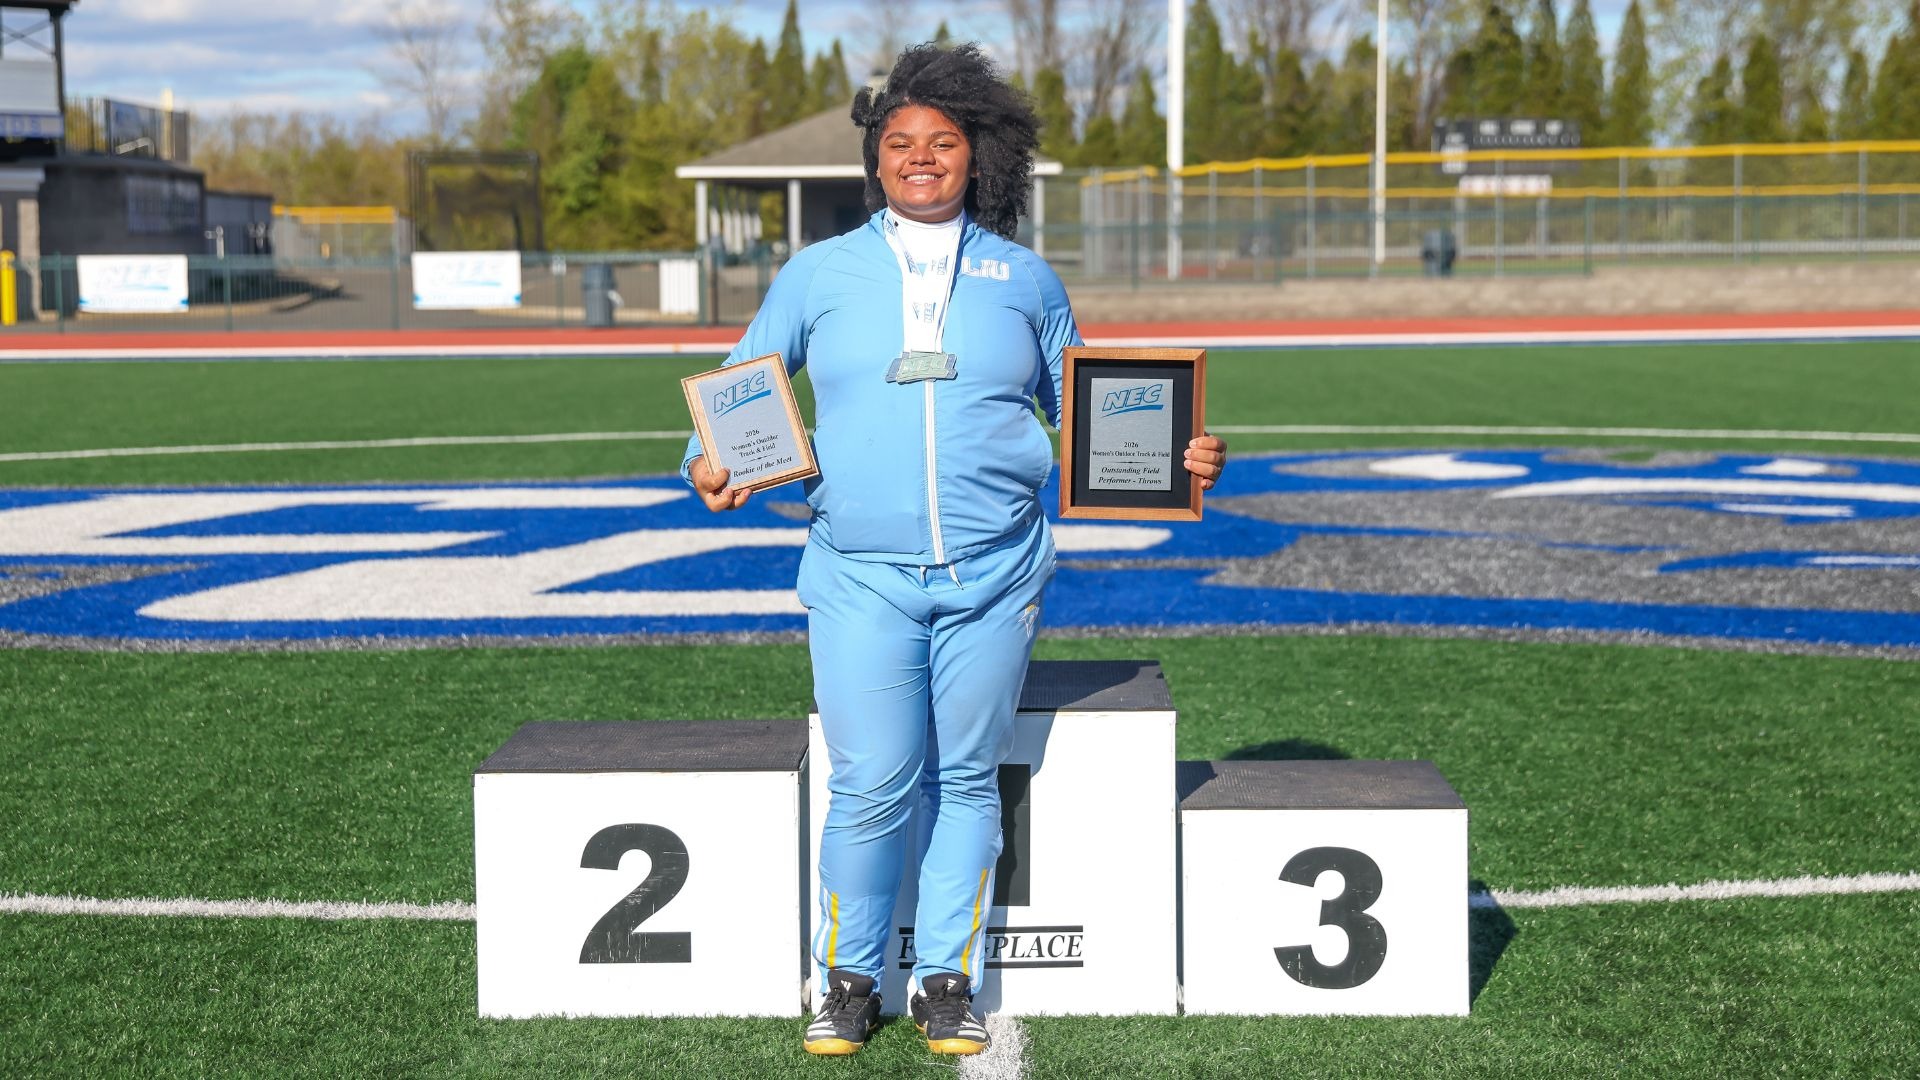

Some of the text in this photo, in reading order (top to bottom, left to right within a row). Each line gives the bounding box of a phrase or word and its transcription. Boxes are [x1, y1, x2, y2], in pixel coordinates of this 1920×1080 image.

[962, 257, 1010, 281] LIU
[714, 370, 765, 413] NEC
[1102, 384, 1163, 411] NEC
[745, 429, 760, 438] 2026
[739, 449, 755, 458] Track
[733, 456, 792, 478] Rookie of the Meet
[1101, 467, 1141, 475] Outstanding
[1098, 476, 1131, 485] Performer
[1138, 477, 1162, 485] Throws
[579, 823, 692, 964] 2
[1273, 846, 1388, 990] 3
[991, 934, 1083, 959] PLACE
